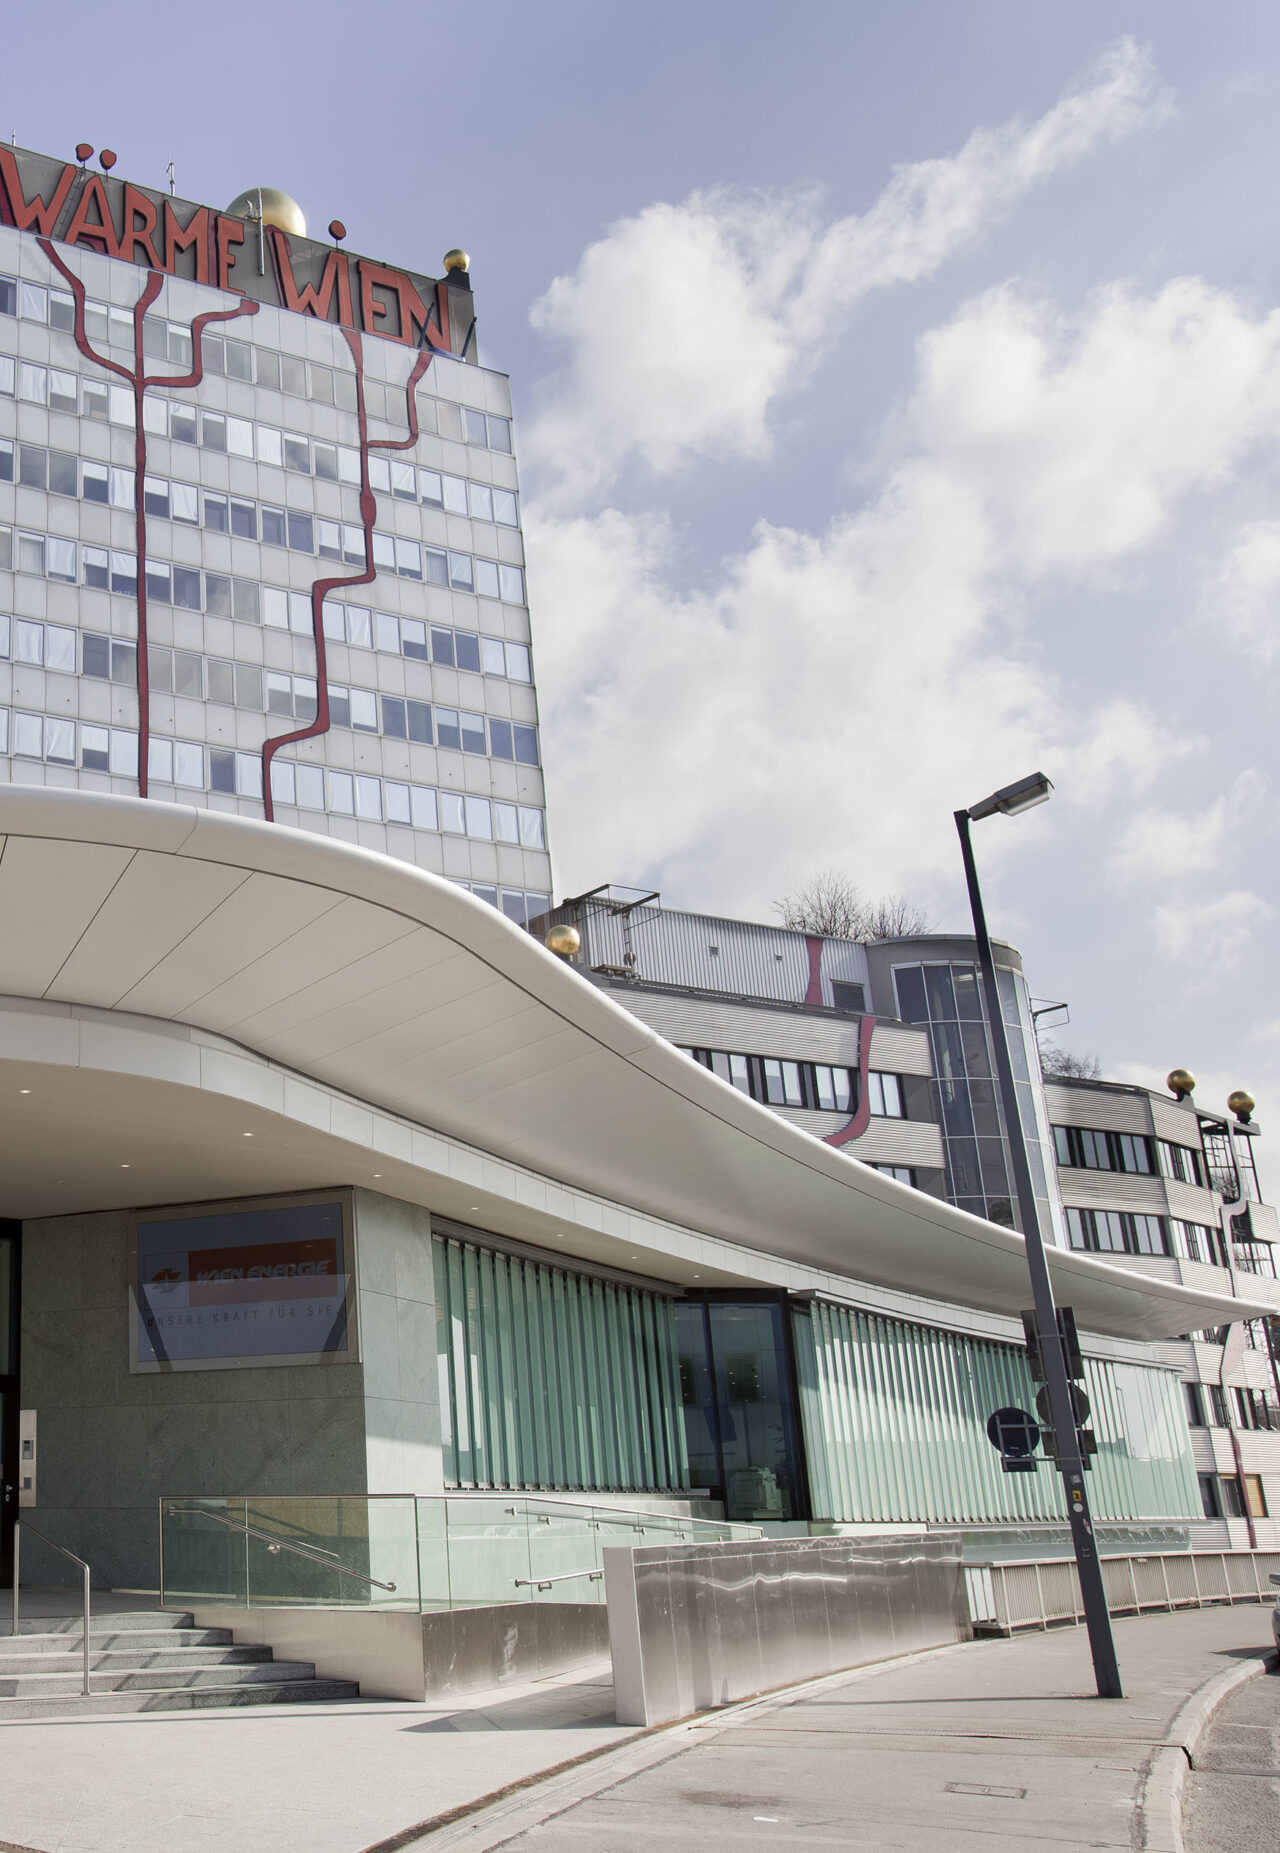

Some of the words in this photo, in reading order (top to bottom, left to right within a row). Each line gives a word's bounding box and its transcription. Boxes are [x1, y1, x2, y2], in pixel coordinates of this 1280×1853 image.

[269, 220, 452, 354] WIEN
[197, 1267, 244, 1286] WIEN
[247, 1259, 331, 1283] ENERGIE
[147, 1313, 203, 1328] UNSERE
[213, 1310, 258, 1323] KRAFT
[270, 1305, 297, 1318] FÜR
